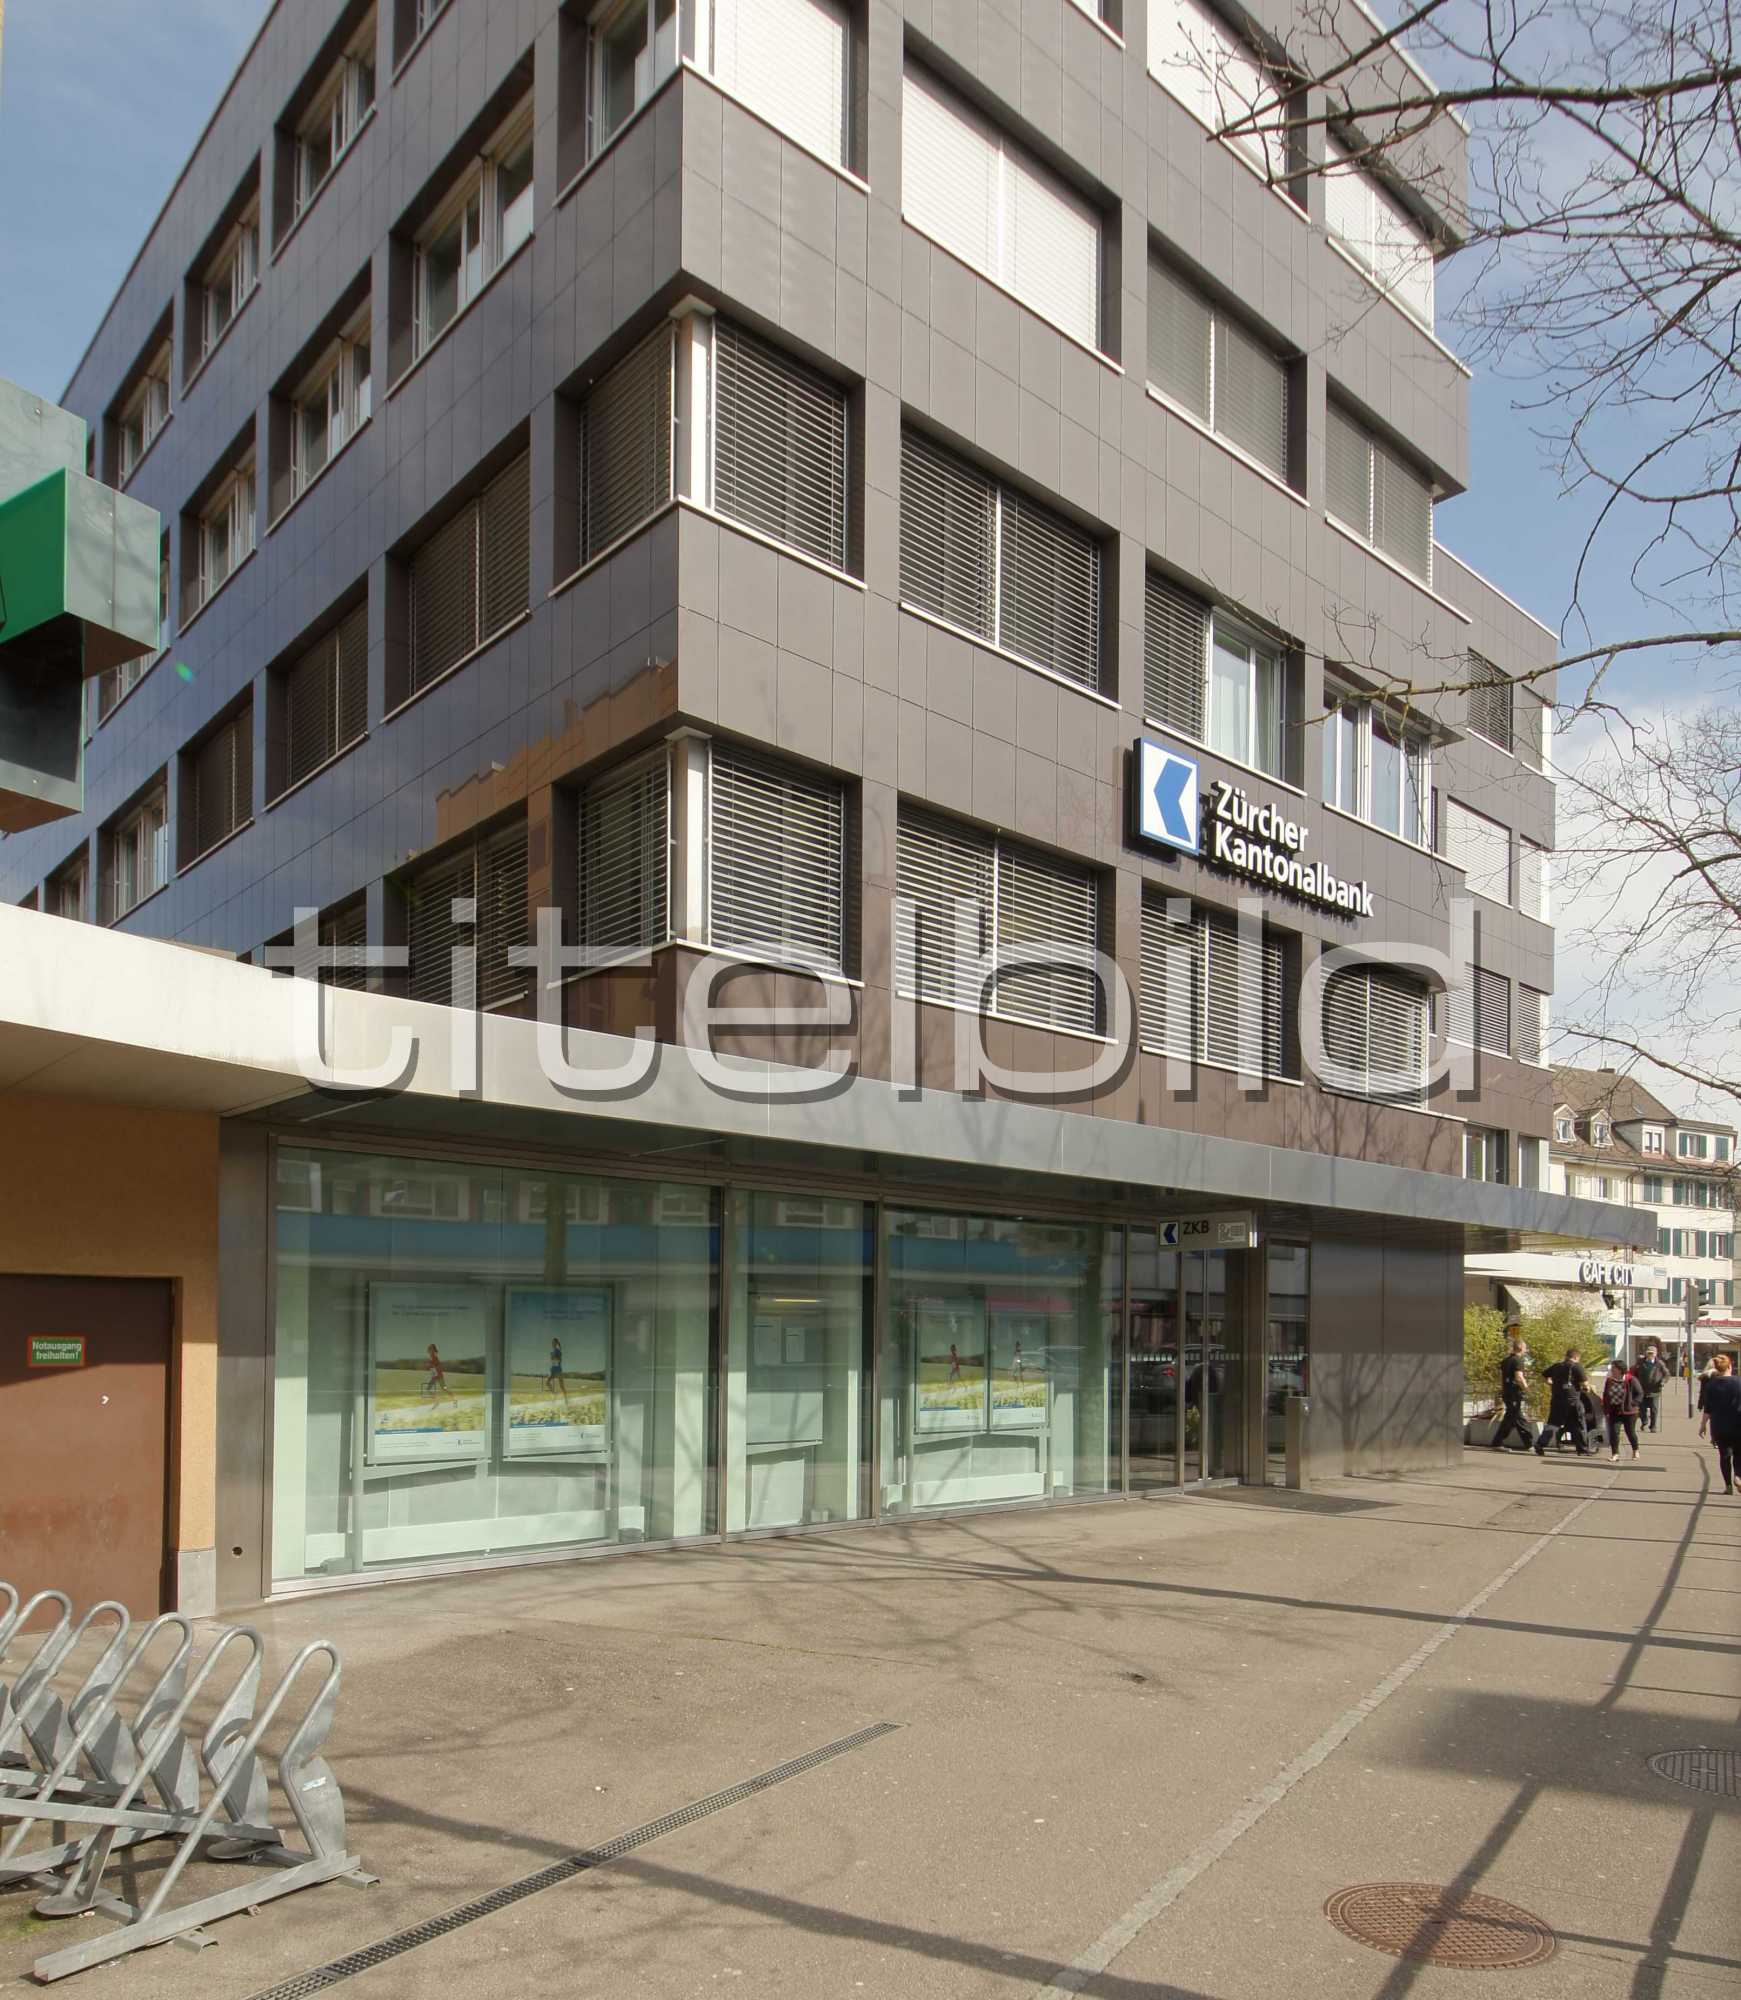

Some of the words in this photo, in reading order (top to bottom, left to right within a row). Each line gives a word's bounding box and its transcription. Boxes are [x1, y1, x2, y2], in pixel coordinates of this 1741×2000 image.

[1215, 780, 1309, 852] Zürcher
[1214, 821, 1374, 917] Kantonalbank
[1182, 1220, 1210, 1235] ZKB
[32, 1341, 82, 1353] Notausgang
